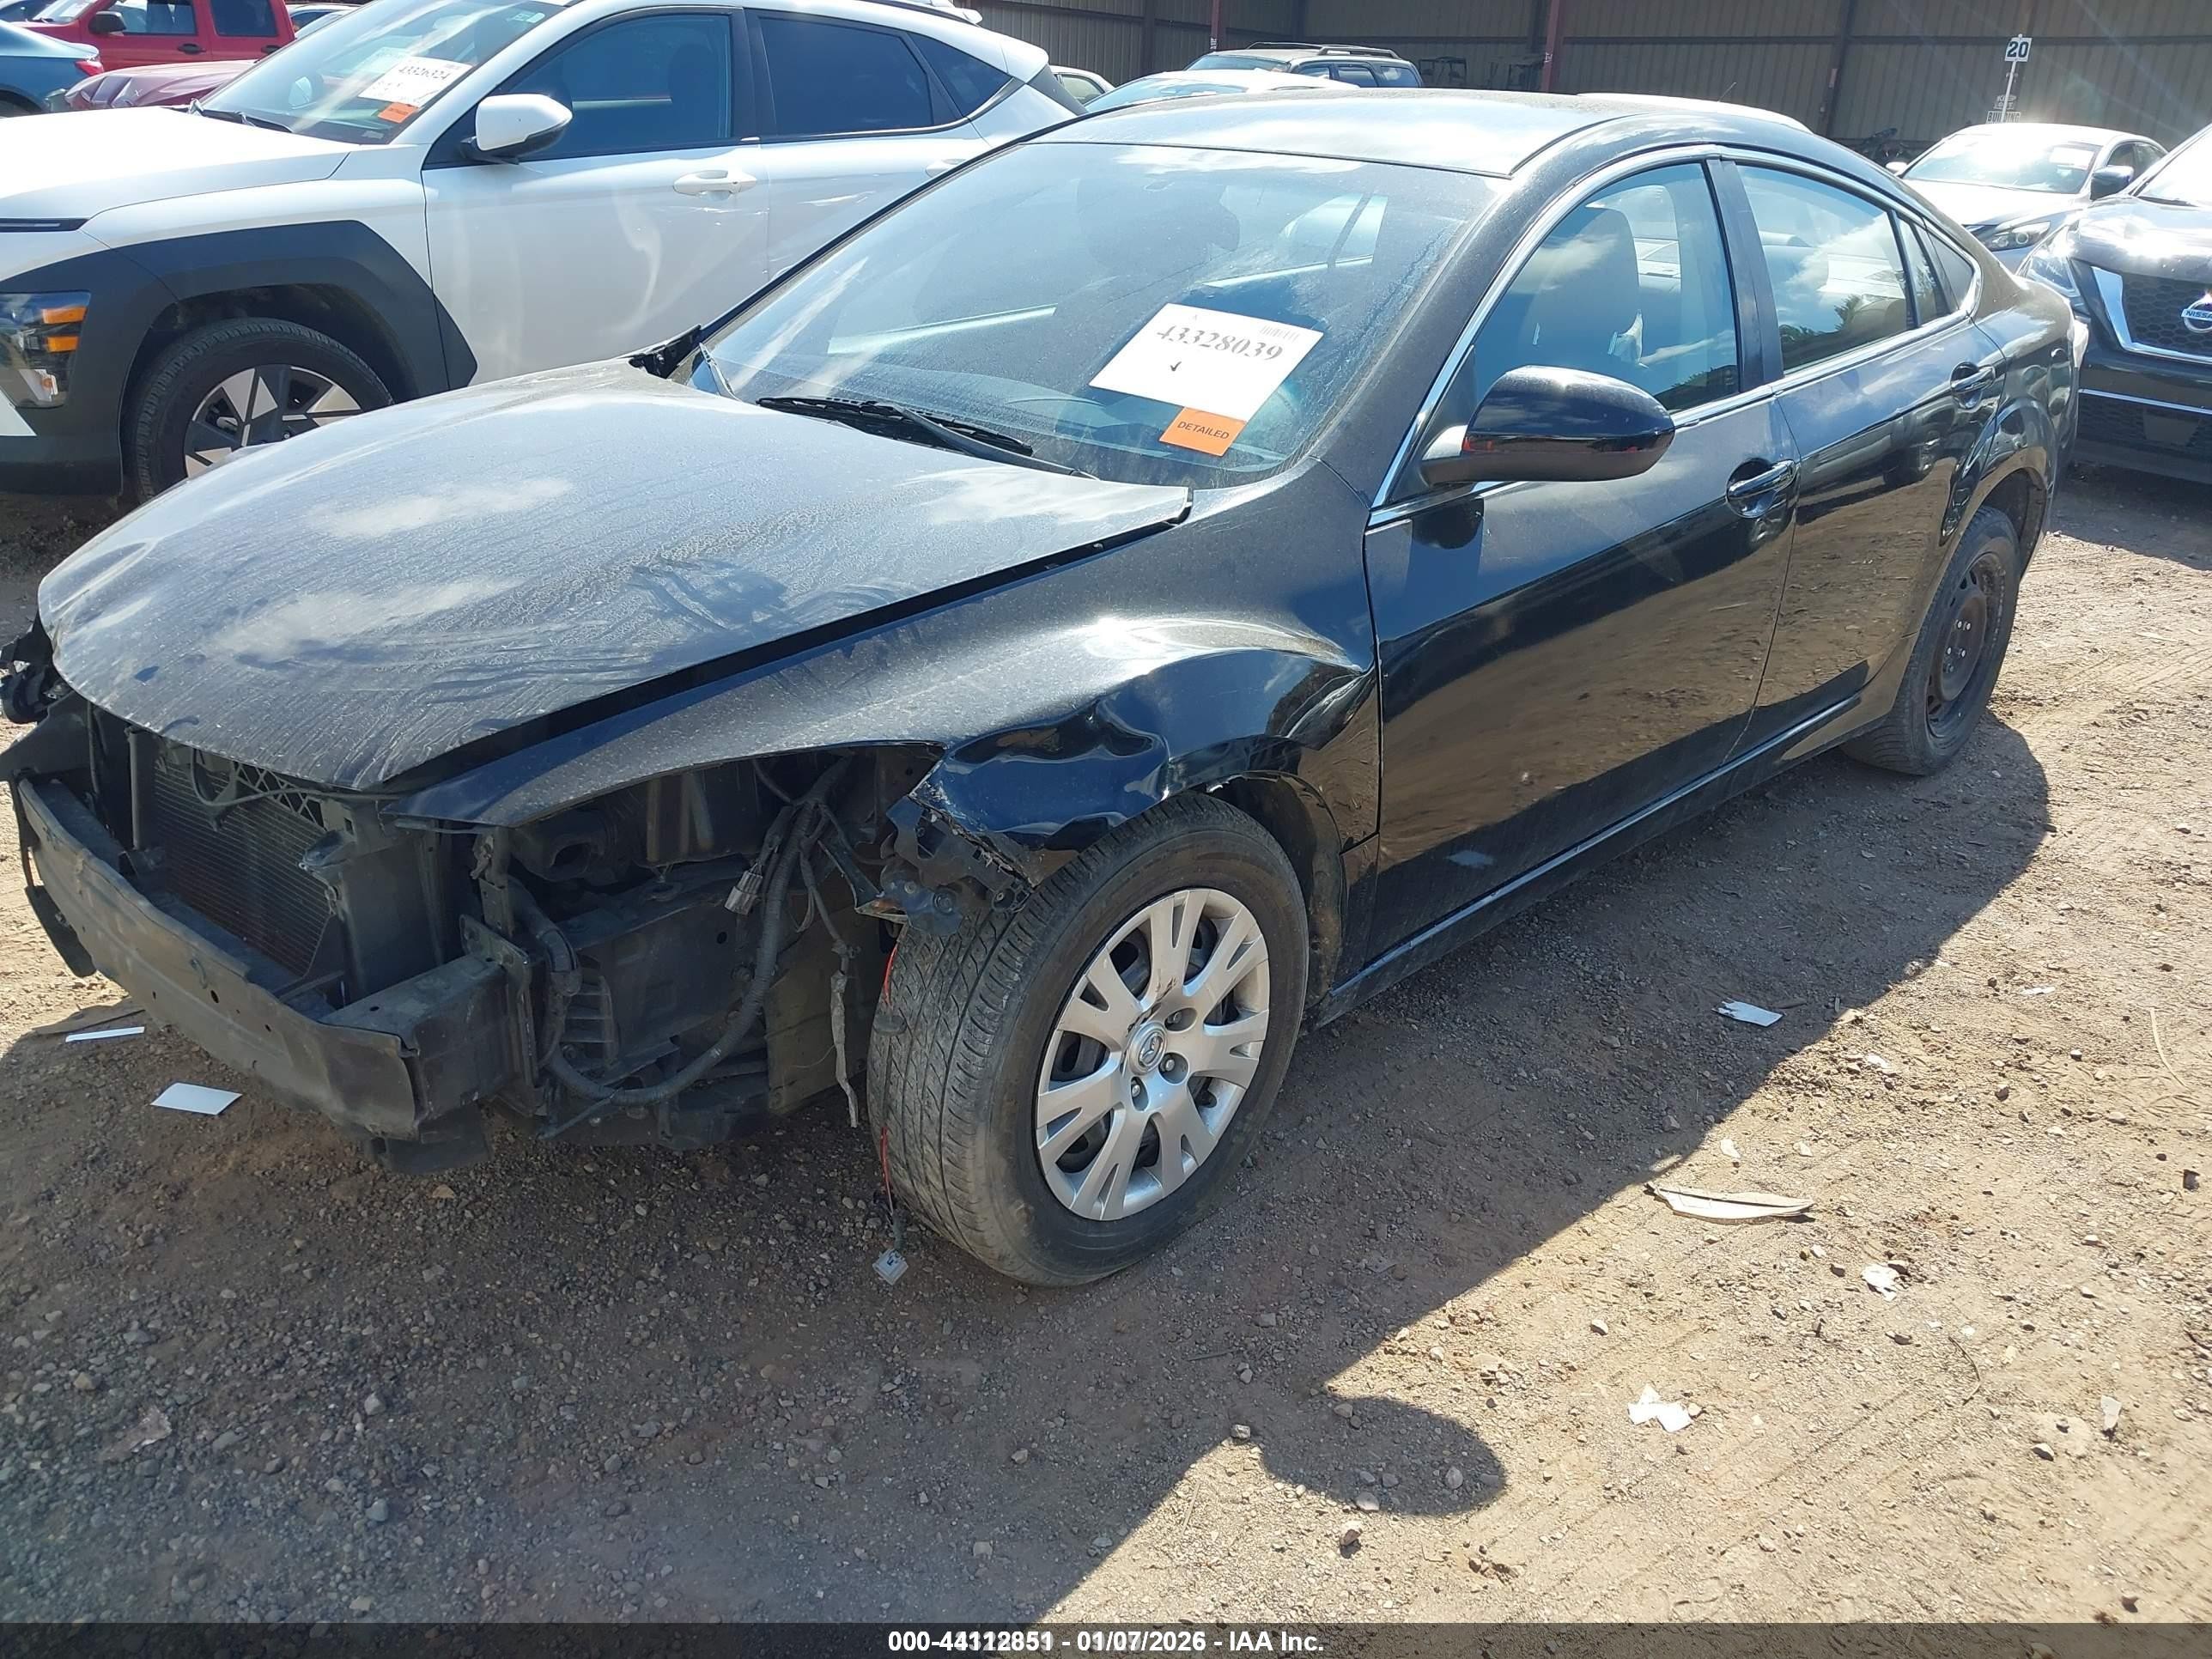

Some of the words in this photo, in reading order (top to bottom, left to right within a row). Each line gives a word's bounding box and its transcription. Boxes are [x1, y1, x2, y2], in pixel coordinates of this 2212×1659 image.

[2007, 41, 2029, 58] 20
[1157, 325, 1284, 361] 43328039
[1176, 421, 1230, 440] DETAILED
